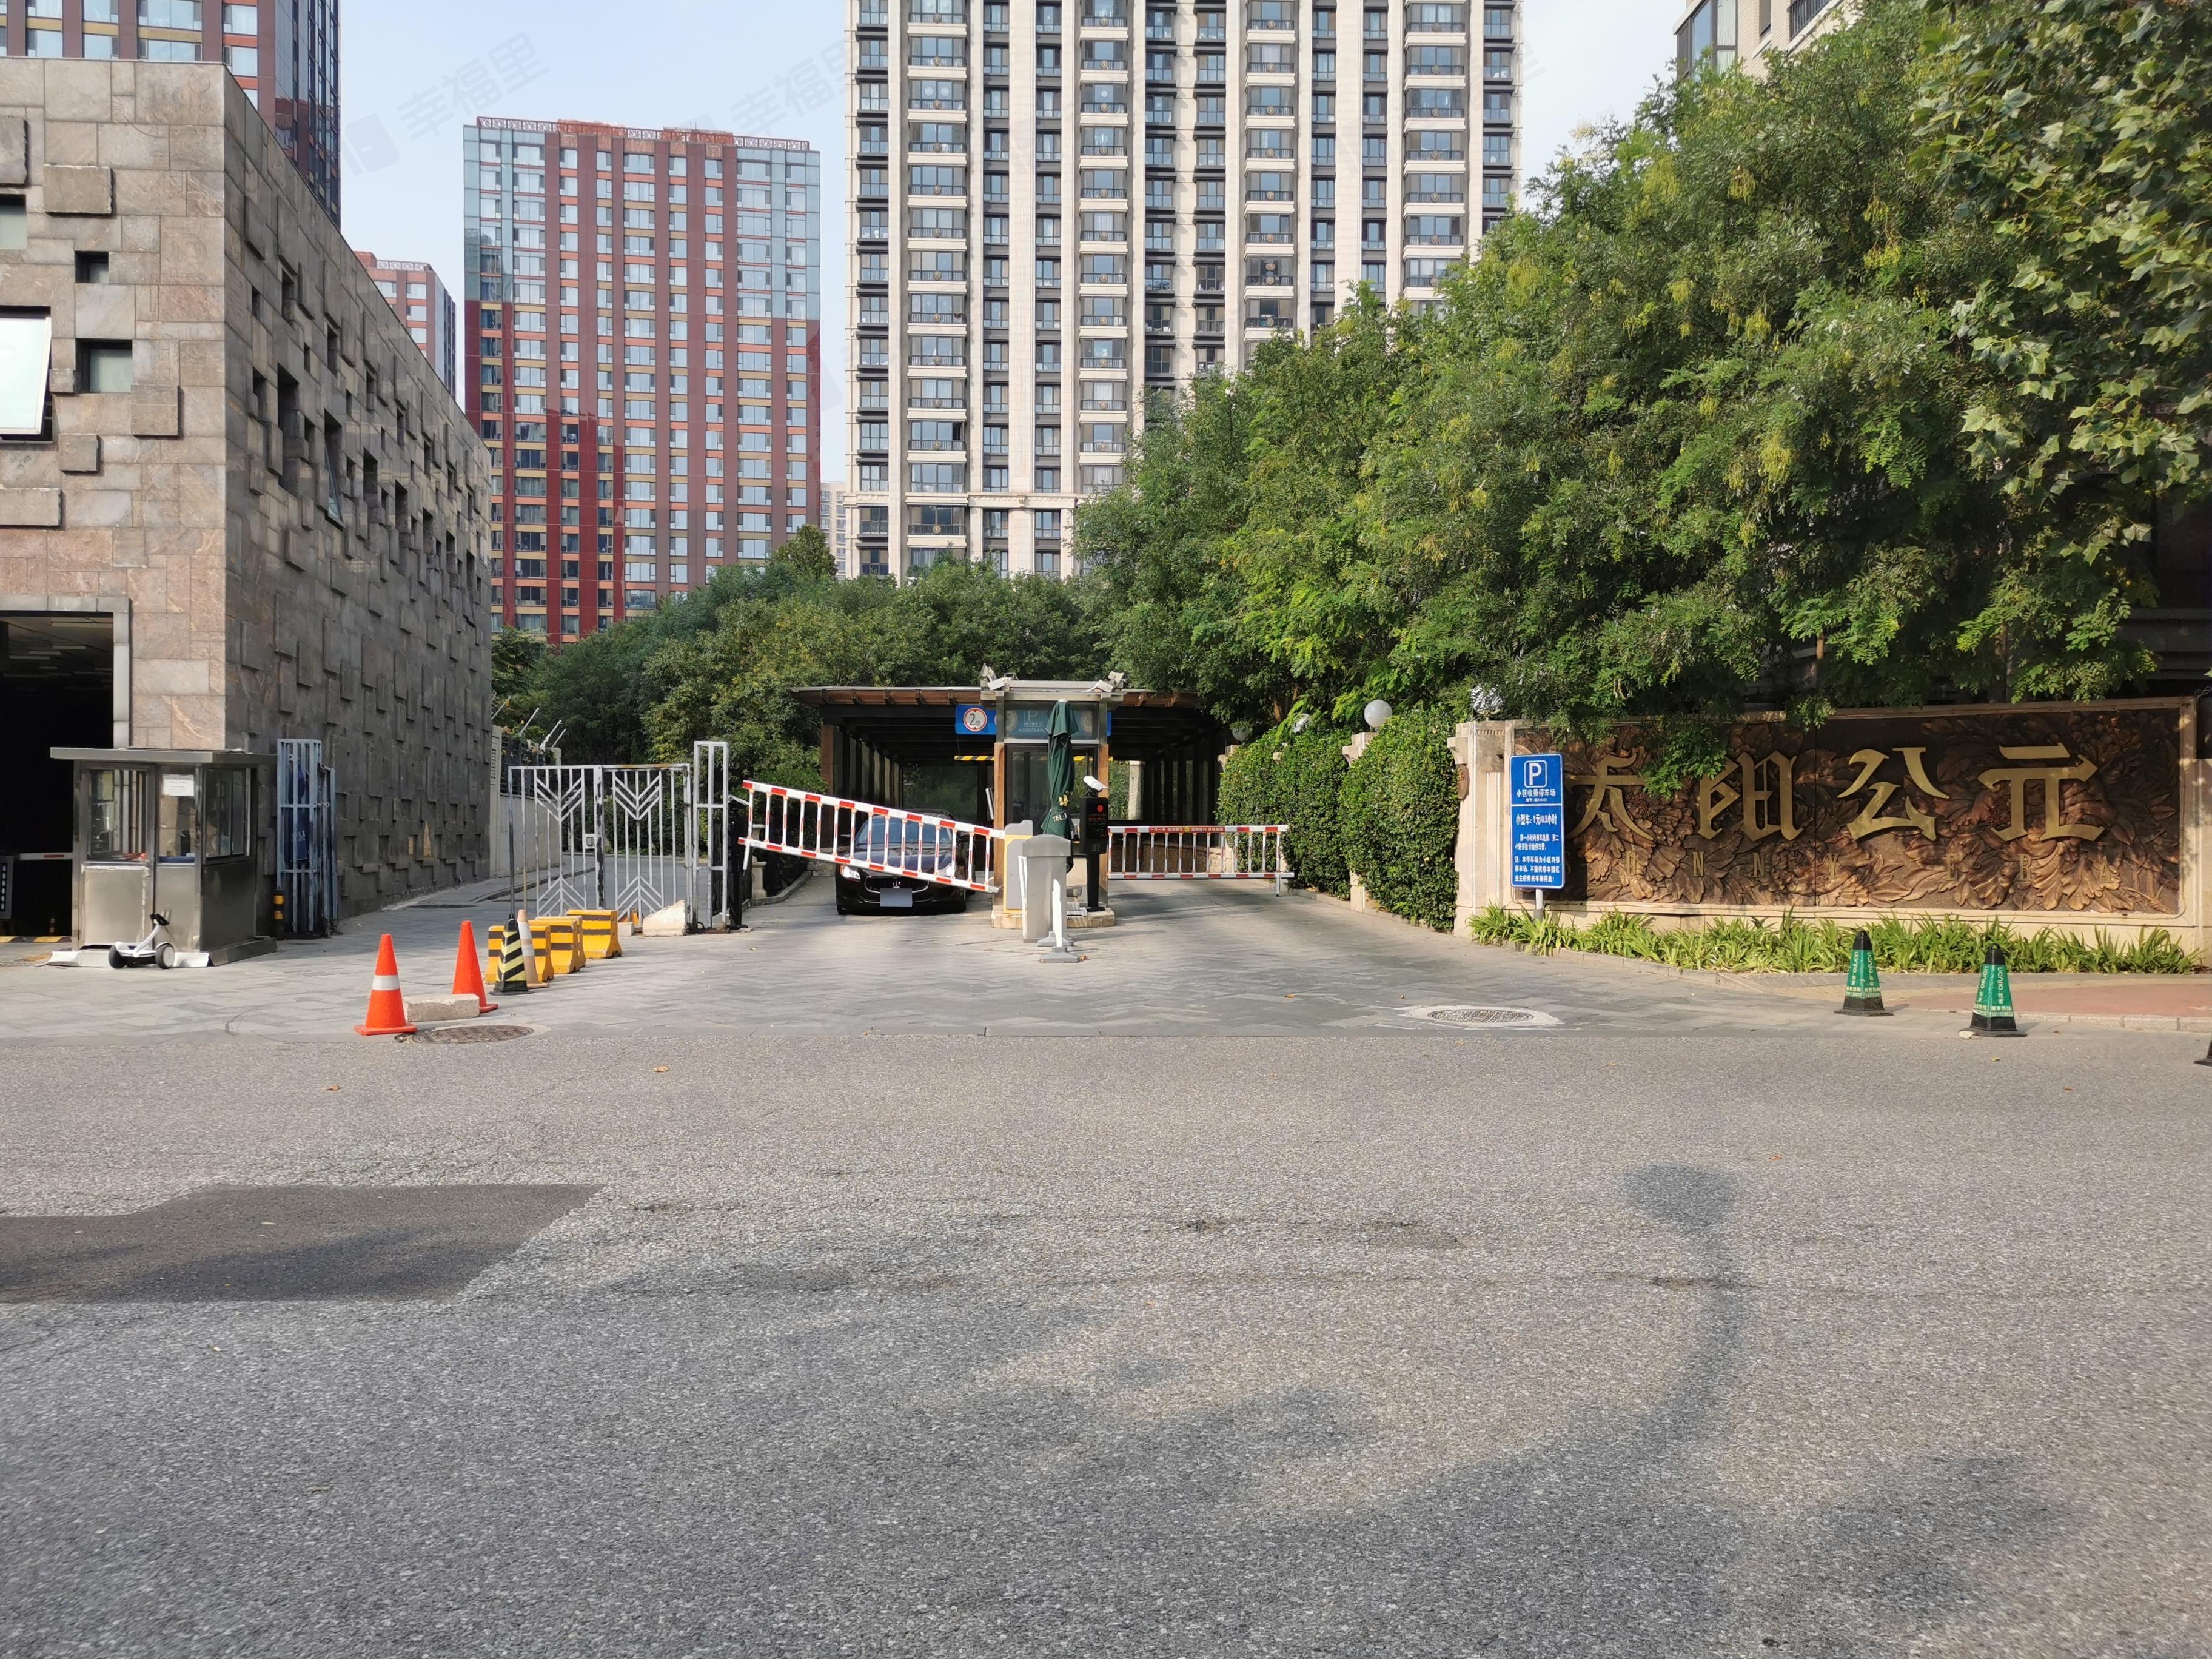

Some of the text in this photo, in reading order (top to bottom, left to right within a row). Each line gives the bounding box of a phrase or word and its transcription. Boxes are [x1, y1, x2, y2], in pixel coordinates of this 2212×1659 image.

[970, 713, 980, 726] 2m
[1529, 763, 1541, 786] P
[1516, 789, 1557, 798] 小区收费停车场
[1565, 742, 2105, 842] 太阳公元
